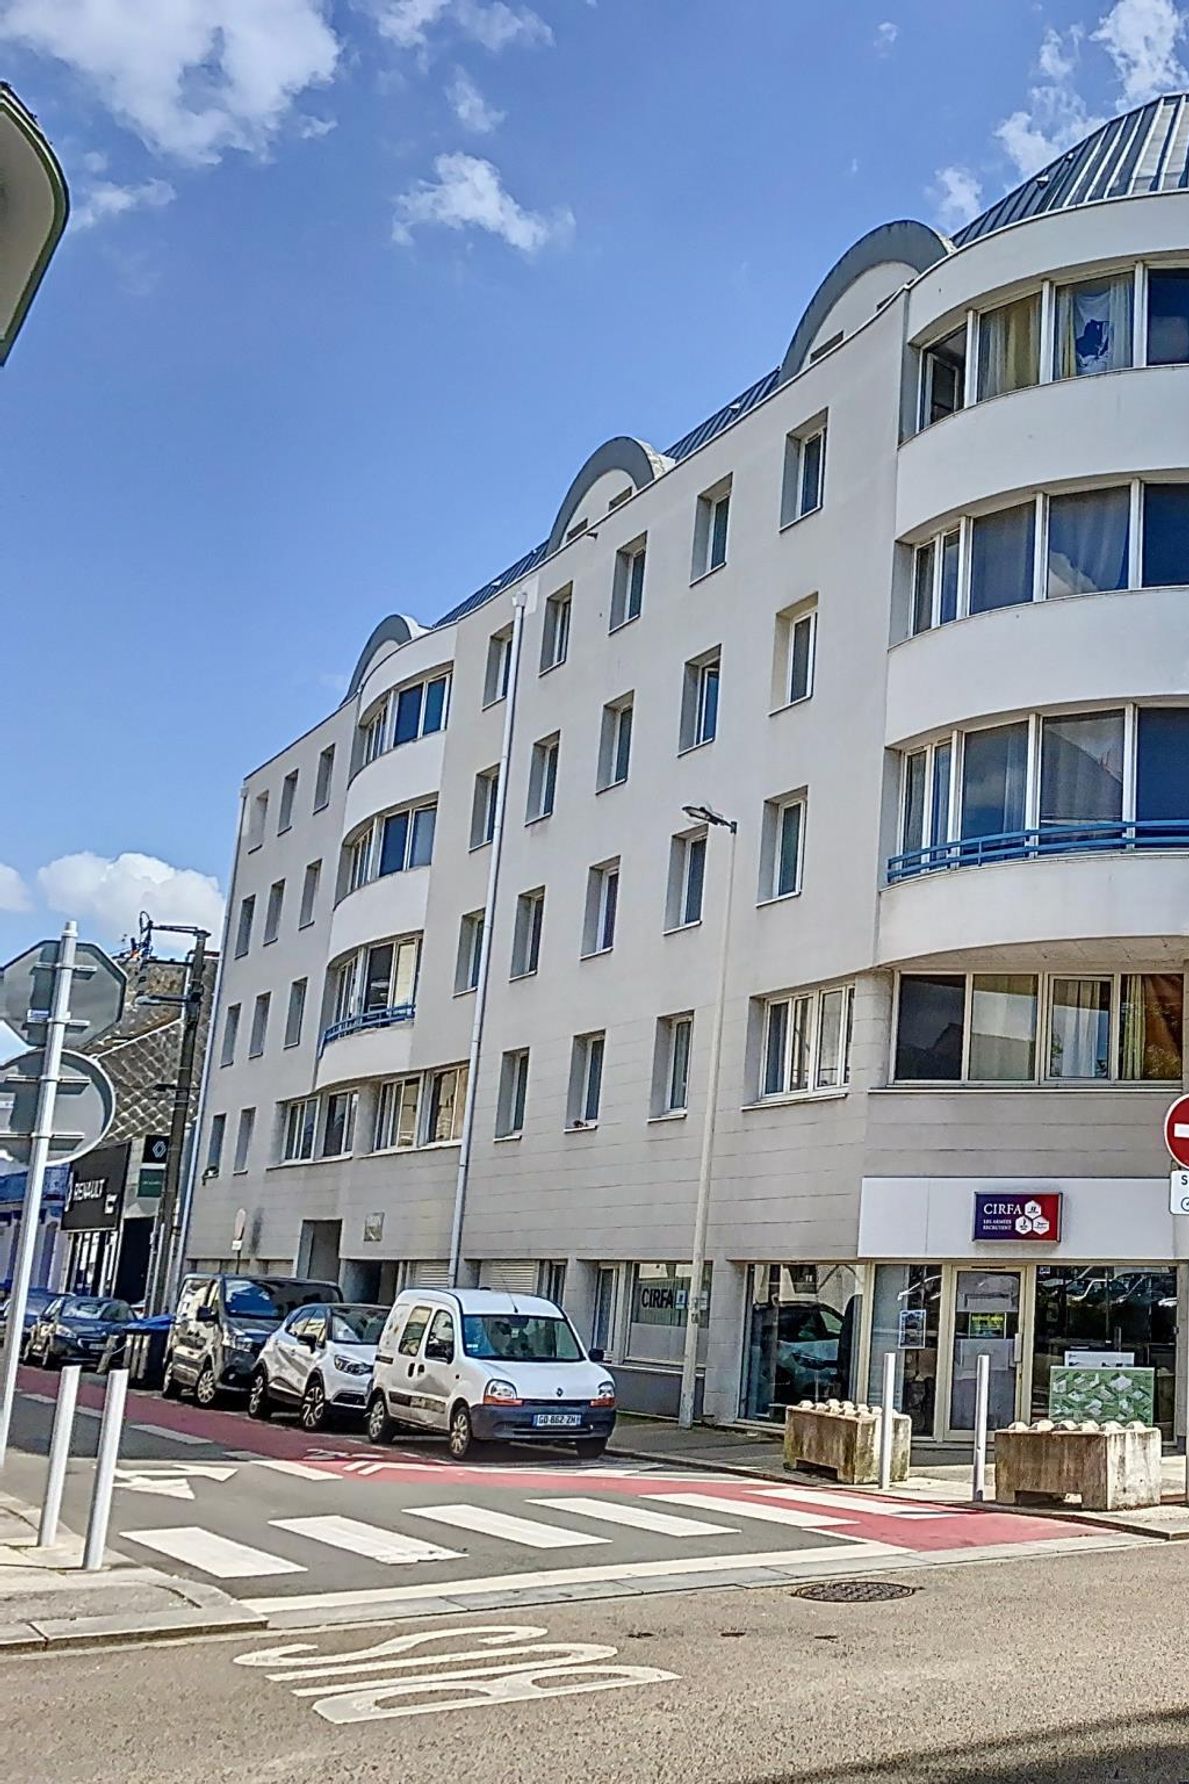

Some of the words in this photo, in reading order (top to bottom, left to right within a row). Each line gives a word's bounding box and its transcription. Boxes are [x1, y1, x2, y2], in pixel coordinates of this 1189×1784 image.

[983, 1203, 1022, 1215] CIRFA
[642, 1288, 673, 1309] CIRFA
[232, 1625, 683, 1724] BUS
